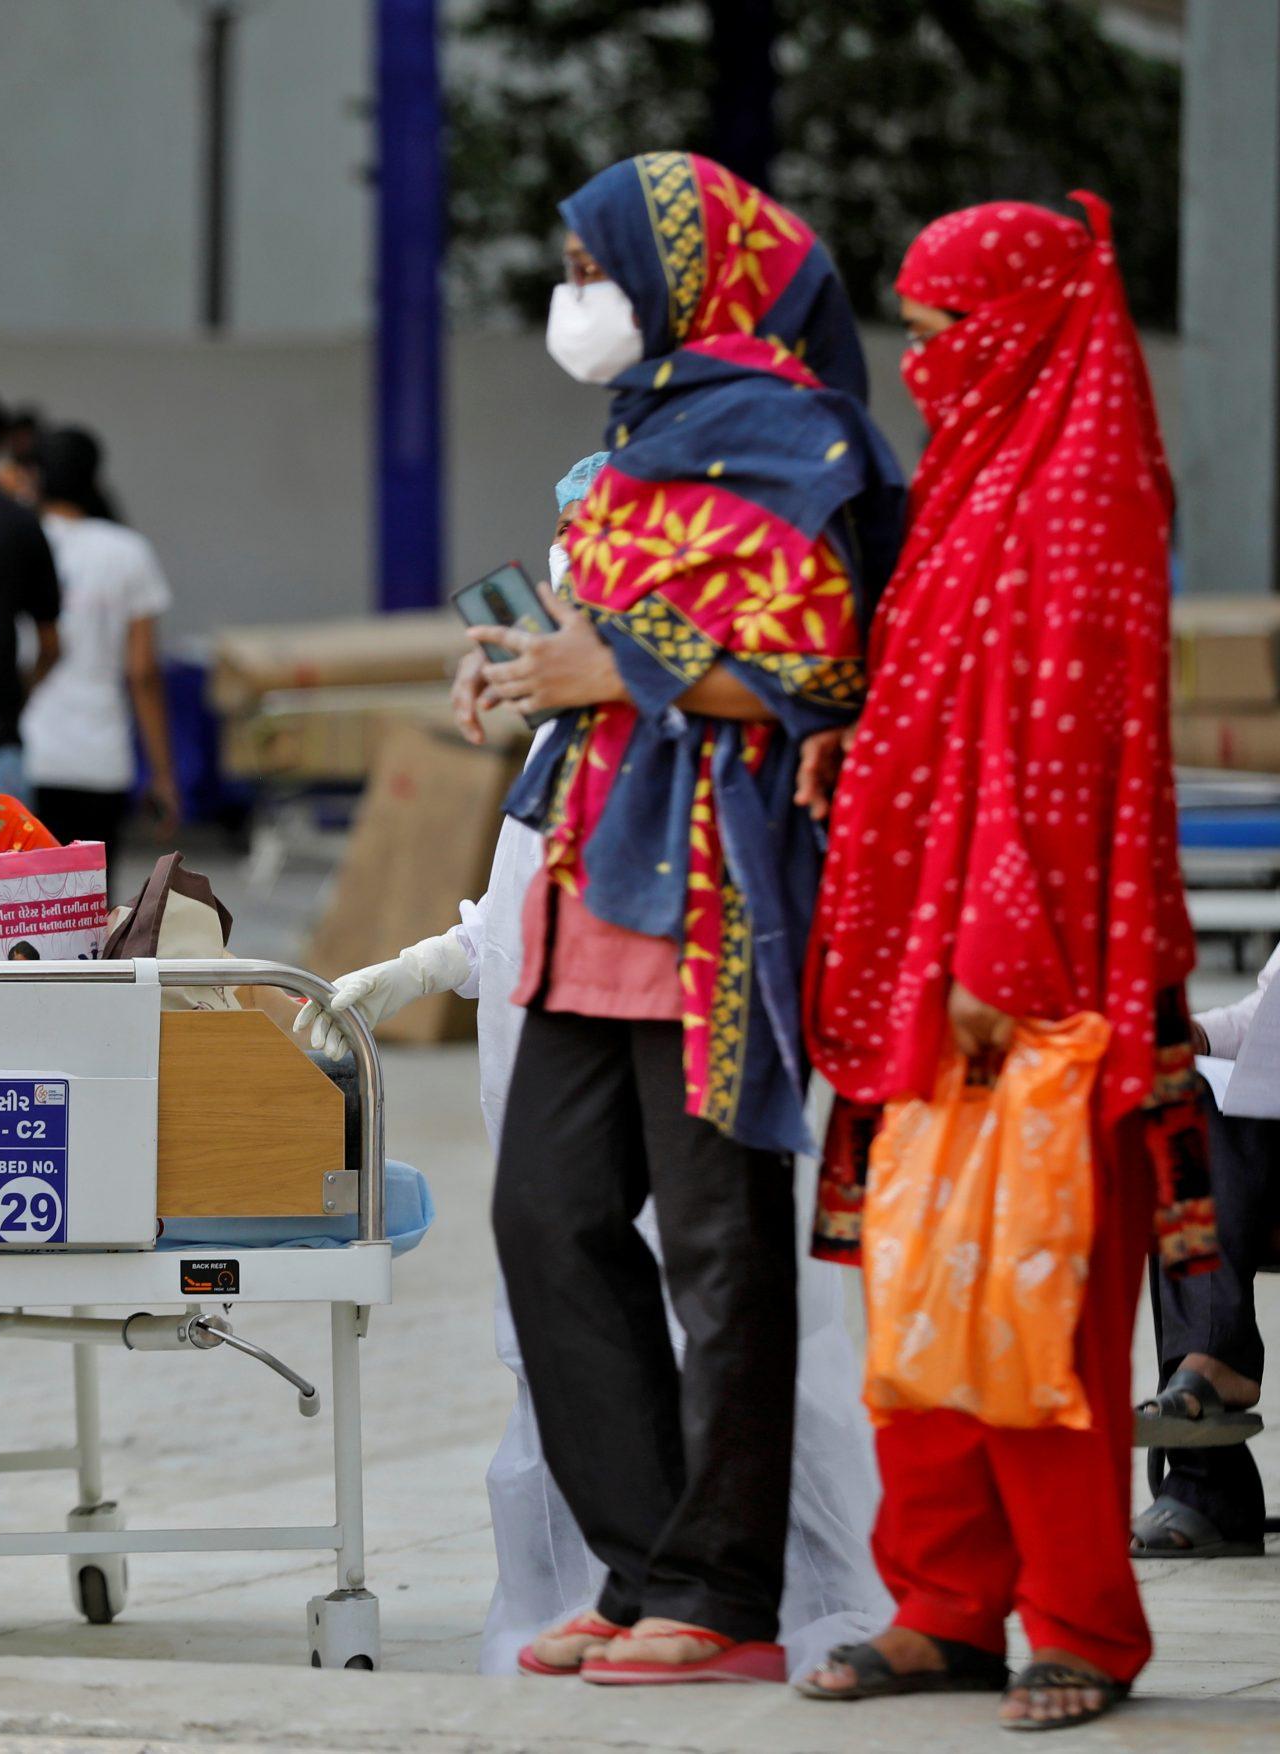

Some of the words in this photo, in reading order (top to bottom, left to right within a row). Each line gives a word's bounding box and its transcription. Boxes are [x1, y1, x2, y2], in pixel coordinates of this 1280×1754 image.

[16, 1120, 46, 1139] C2
[32, 1160, 58, 1174] NO.
[0, 1191, 58, 1232] 29
